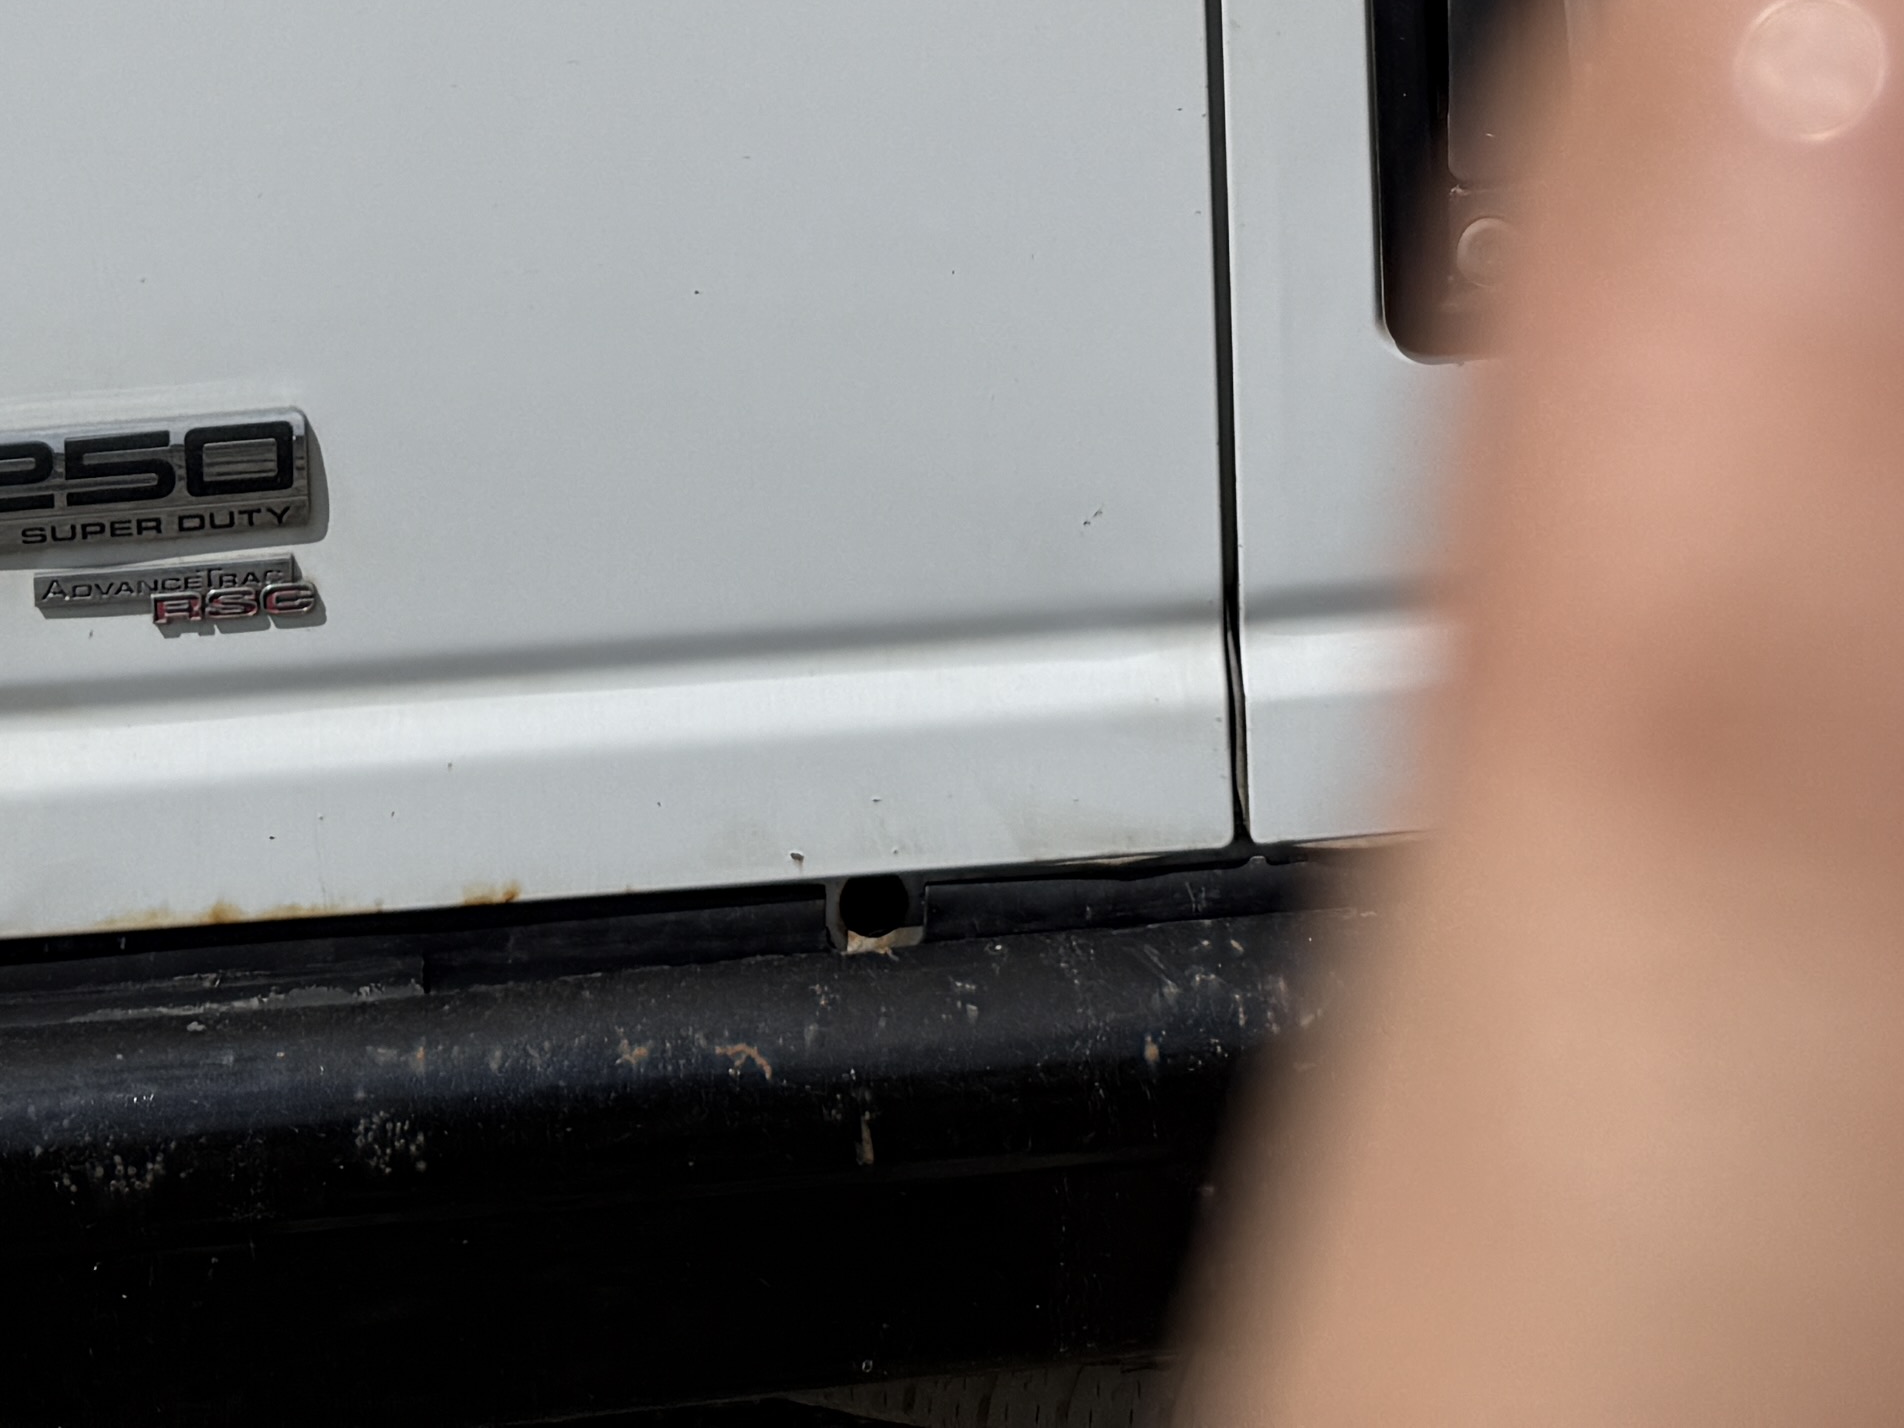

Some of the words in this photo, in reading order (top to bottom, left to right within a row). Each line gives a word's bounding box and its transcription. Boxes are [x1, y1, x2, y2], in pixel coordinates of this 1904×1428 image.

[22, 516, 163, 544] SUPER
[178, 505, 291, 532] DUTY
[152, 581, 316, 624] RSC
